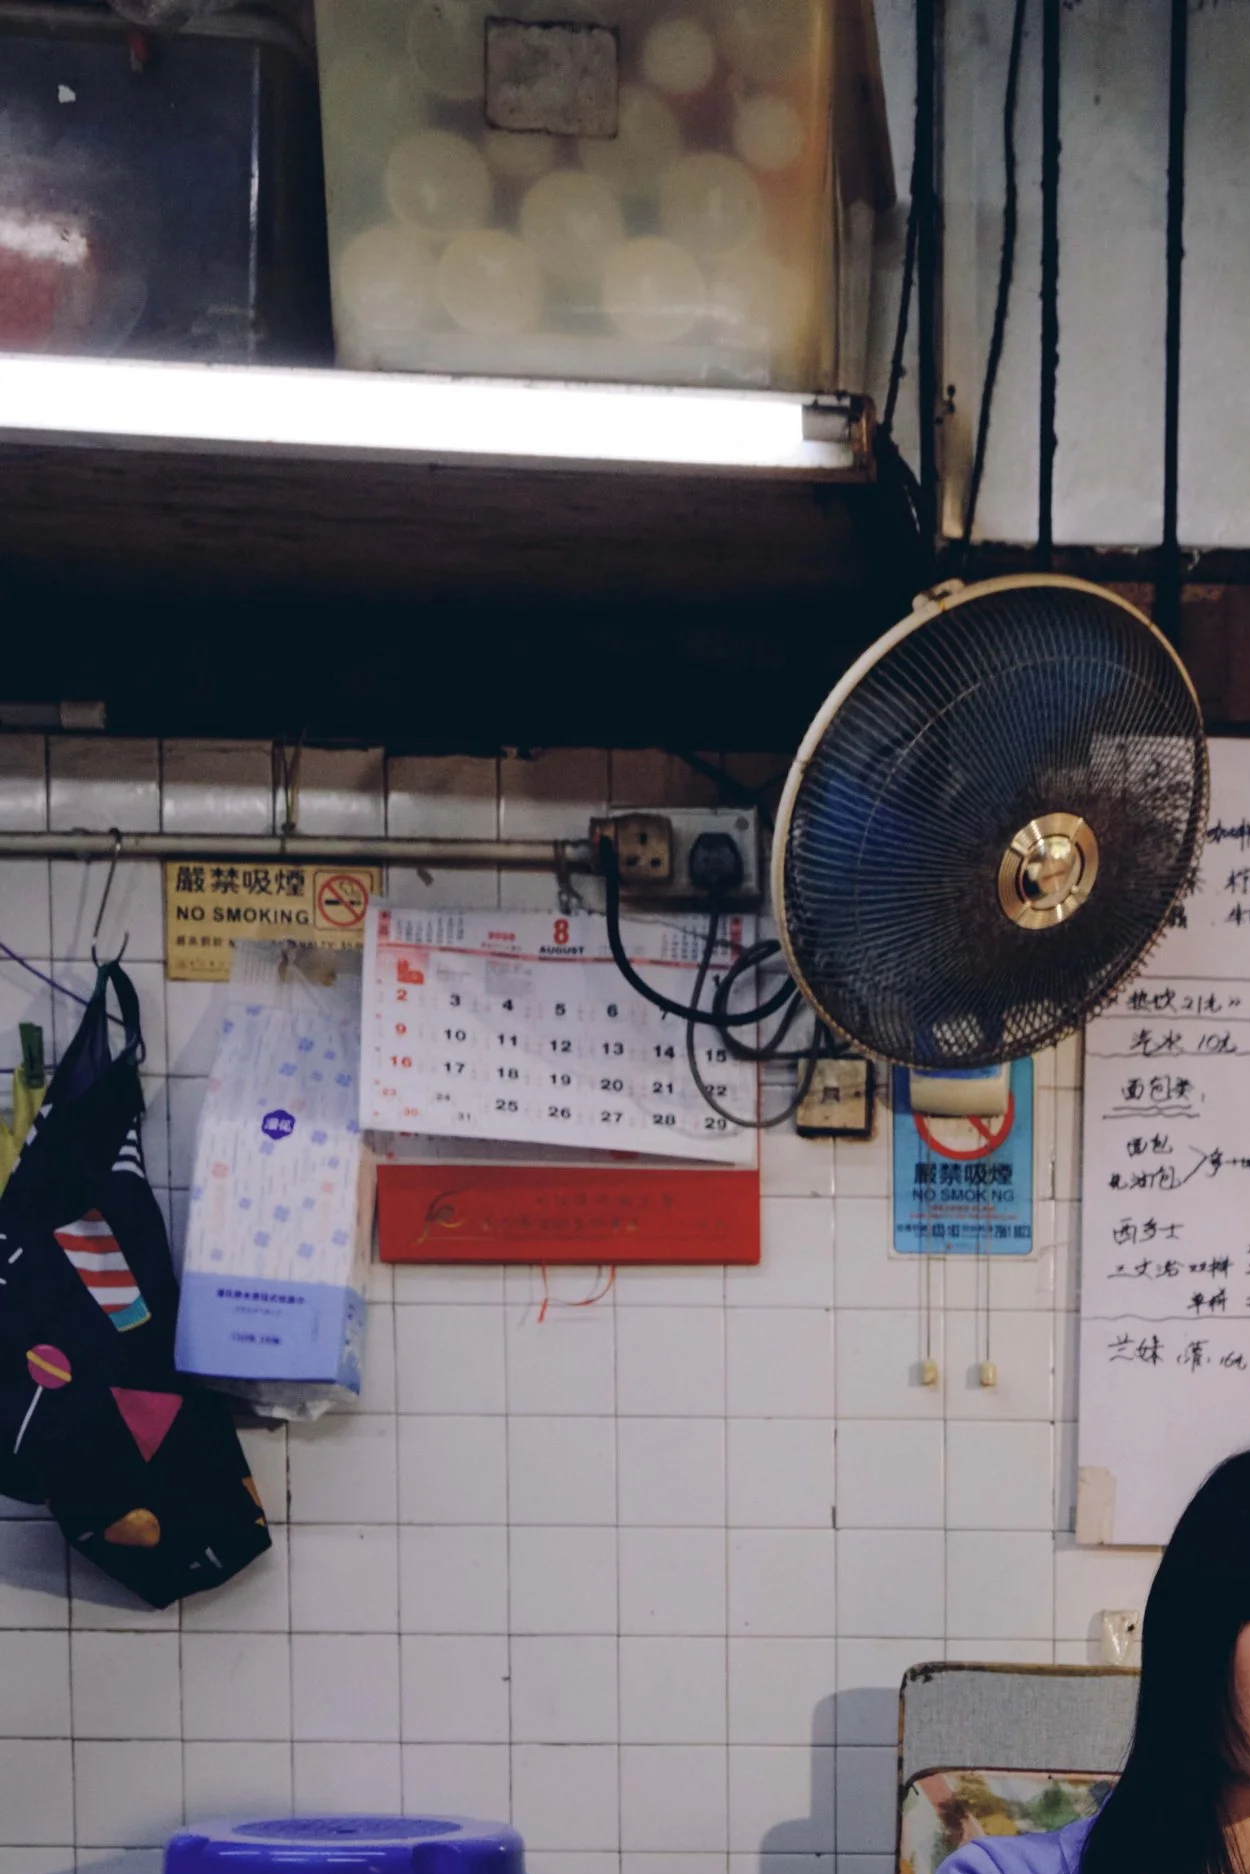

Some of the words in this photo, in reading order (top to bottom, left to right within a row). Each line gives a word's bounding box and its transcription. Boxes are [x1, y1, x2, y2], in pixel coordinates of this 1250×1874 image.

[175, 866, 306, 897] 嚴禁吸煙
[176, 906, 205, 922] NO
[212, 908, 310, 925] SMOKING
[554, 918, 569, 945] 8
[539, 945, 585, 955] AUGUST
[396, 988, 408, 1001] 2
[450, 994, 461, 1007] 3
[502, 999, 514, 1012] 4
[555, 1003, 566, 1016] 5
[607, 1003, 619, 1018] 6
[395, 1023, 407, 1036] 9
[444, 1029, 467, 1041] 10
[498, 1033, 518, 1047] 11
[550, 1039, 572, 1052] 12
[602, 1042, 625, 1056] 13
[654, 1045, 676, 1059] 14
[706, 1049, 728, 1063] 15
[390, 1055, 413, 1068] 16
[444, 1062, 465, 1075] 17
[497, 1067, 519, 1080] 18
[550, 1074, 571, 1086] 19
[600, 1079, 624, 1092] 20
[652, 1082, 674, 1095] 21
[705, 1085, 727, 1098] 22
[496, 1099, 518, 1112] 25
[548, 1107, 571, 1119] 26
[601, 1111, 623, 1124] 27
[652, 1113, 676, 1126] 28
[704, 1117, 728, 1130] 29
[914, 1163, 1014, 1186] 嚴禁吸煙
[913, 1189, 936, 1202] NO
